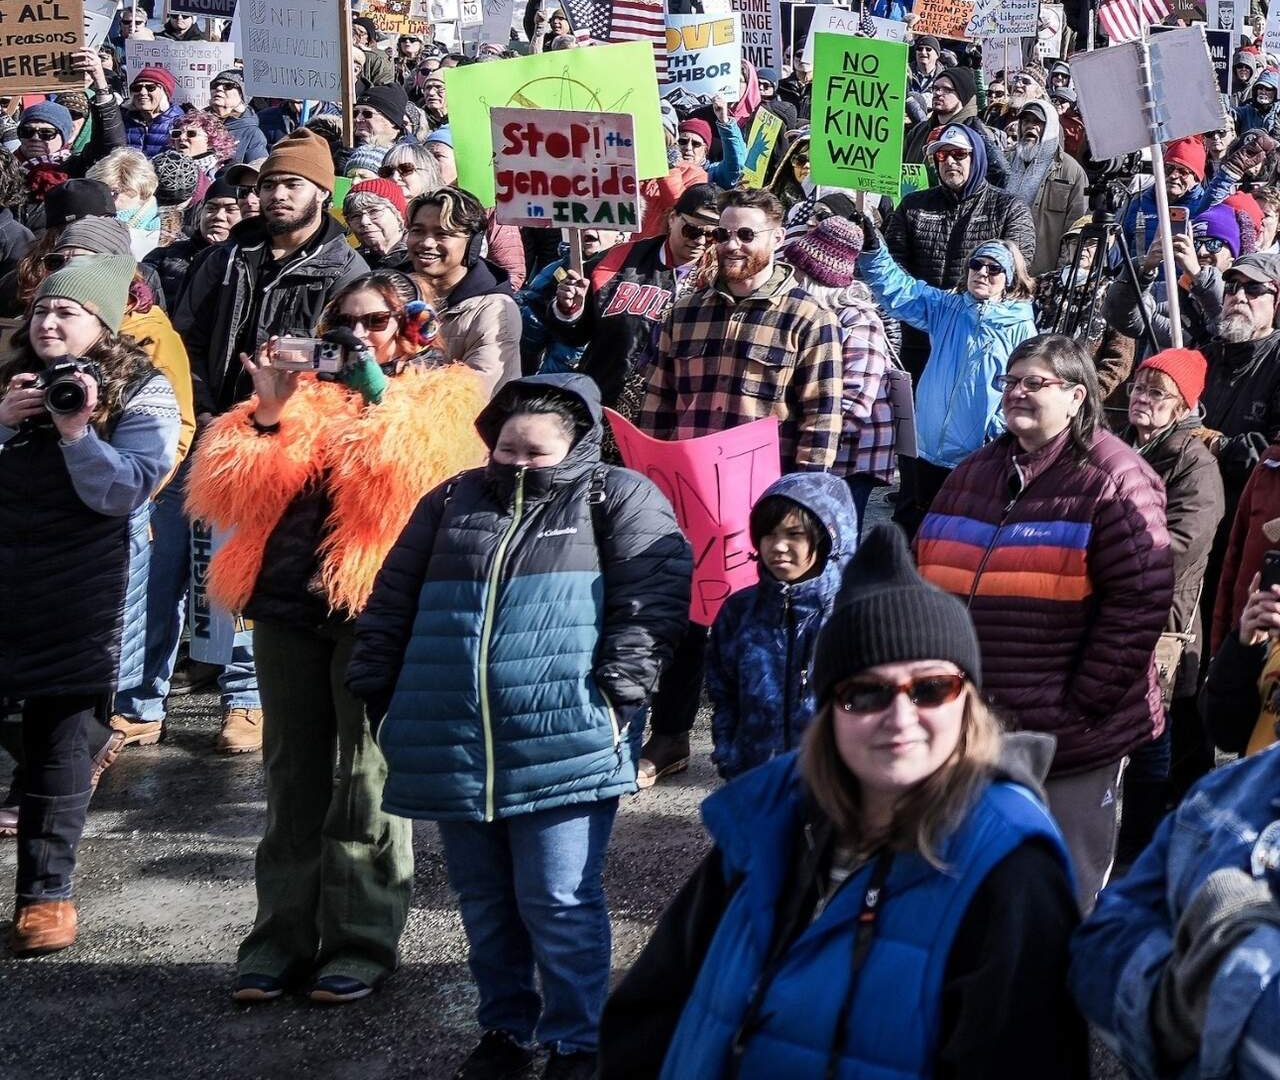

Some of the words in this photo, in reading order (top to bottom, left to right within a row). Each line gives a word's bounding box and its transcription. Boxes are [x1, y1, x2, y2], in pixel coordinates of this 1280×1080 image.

[19, 4, 69, 22] ALL
[1002, 0, 1037, 9] Schools
[250, 5, 318, 29] UNFIT
[920, 12, 969, 27] BRITCHES
[1000, 12, 1034, 21] Libraries
[6, 31, 78, 46] reasons
[249, 29, 337, 60] MALEVOLENT
[843, 51, 879, 74] NO
[827, 77, 899, 110] FAUX-
[825, 107, 889, 143] KING
[606, 132, 632, 148] the
[827, 140, 880, 169] WAY
[497, 167, 635, 202] genocide
[527, 202, 544, 217] in
[553, 201, 636, 224] IRAN
